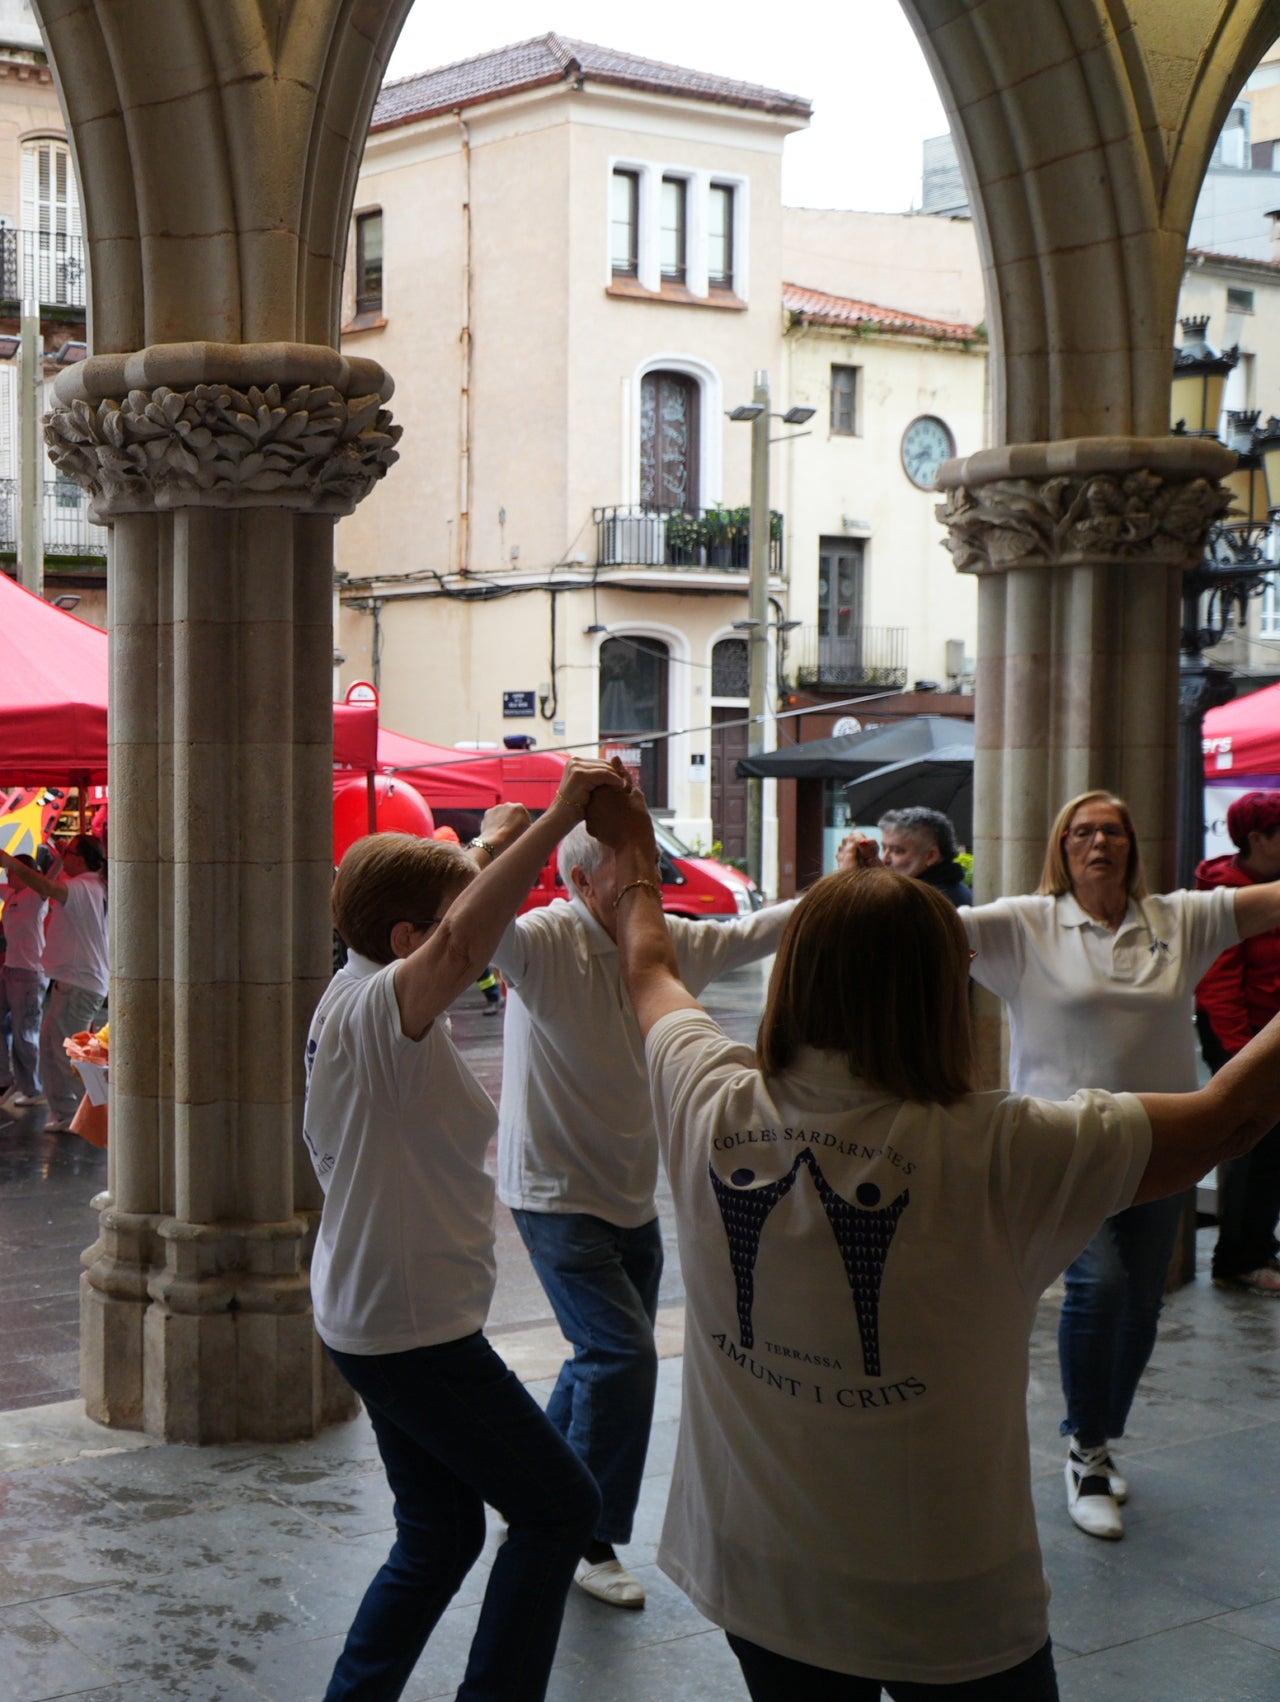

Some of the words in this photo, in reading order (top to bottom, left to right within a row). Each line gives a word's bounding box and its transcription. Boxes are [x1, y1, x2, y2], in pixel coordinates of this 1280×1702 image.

[711, 1333, 801, 1397] AMUNT
[814, 1385, 823, 1404] I
[836, 1376, 927, 1408] CRITS
[764, 1341, 842, 1370] TERRASSA
